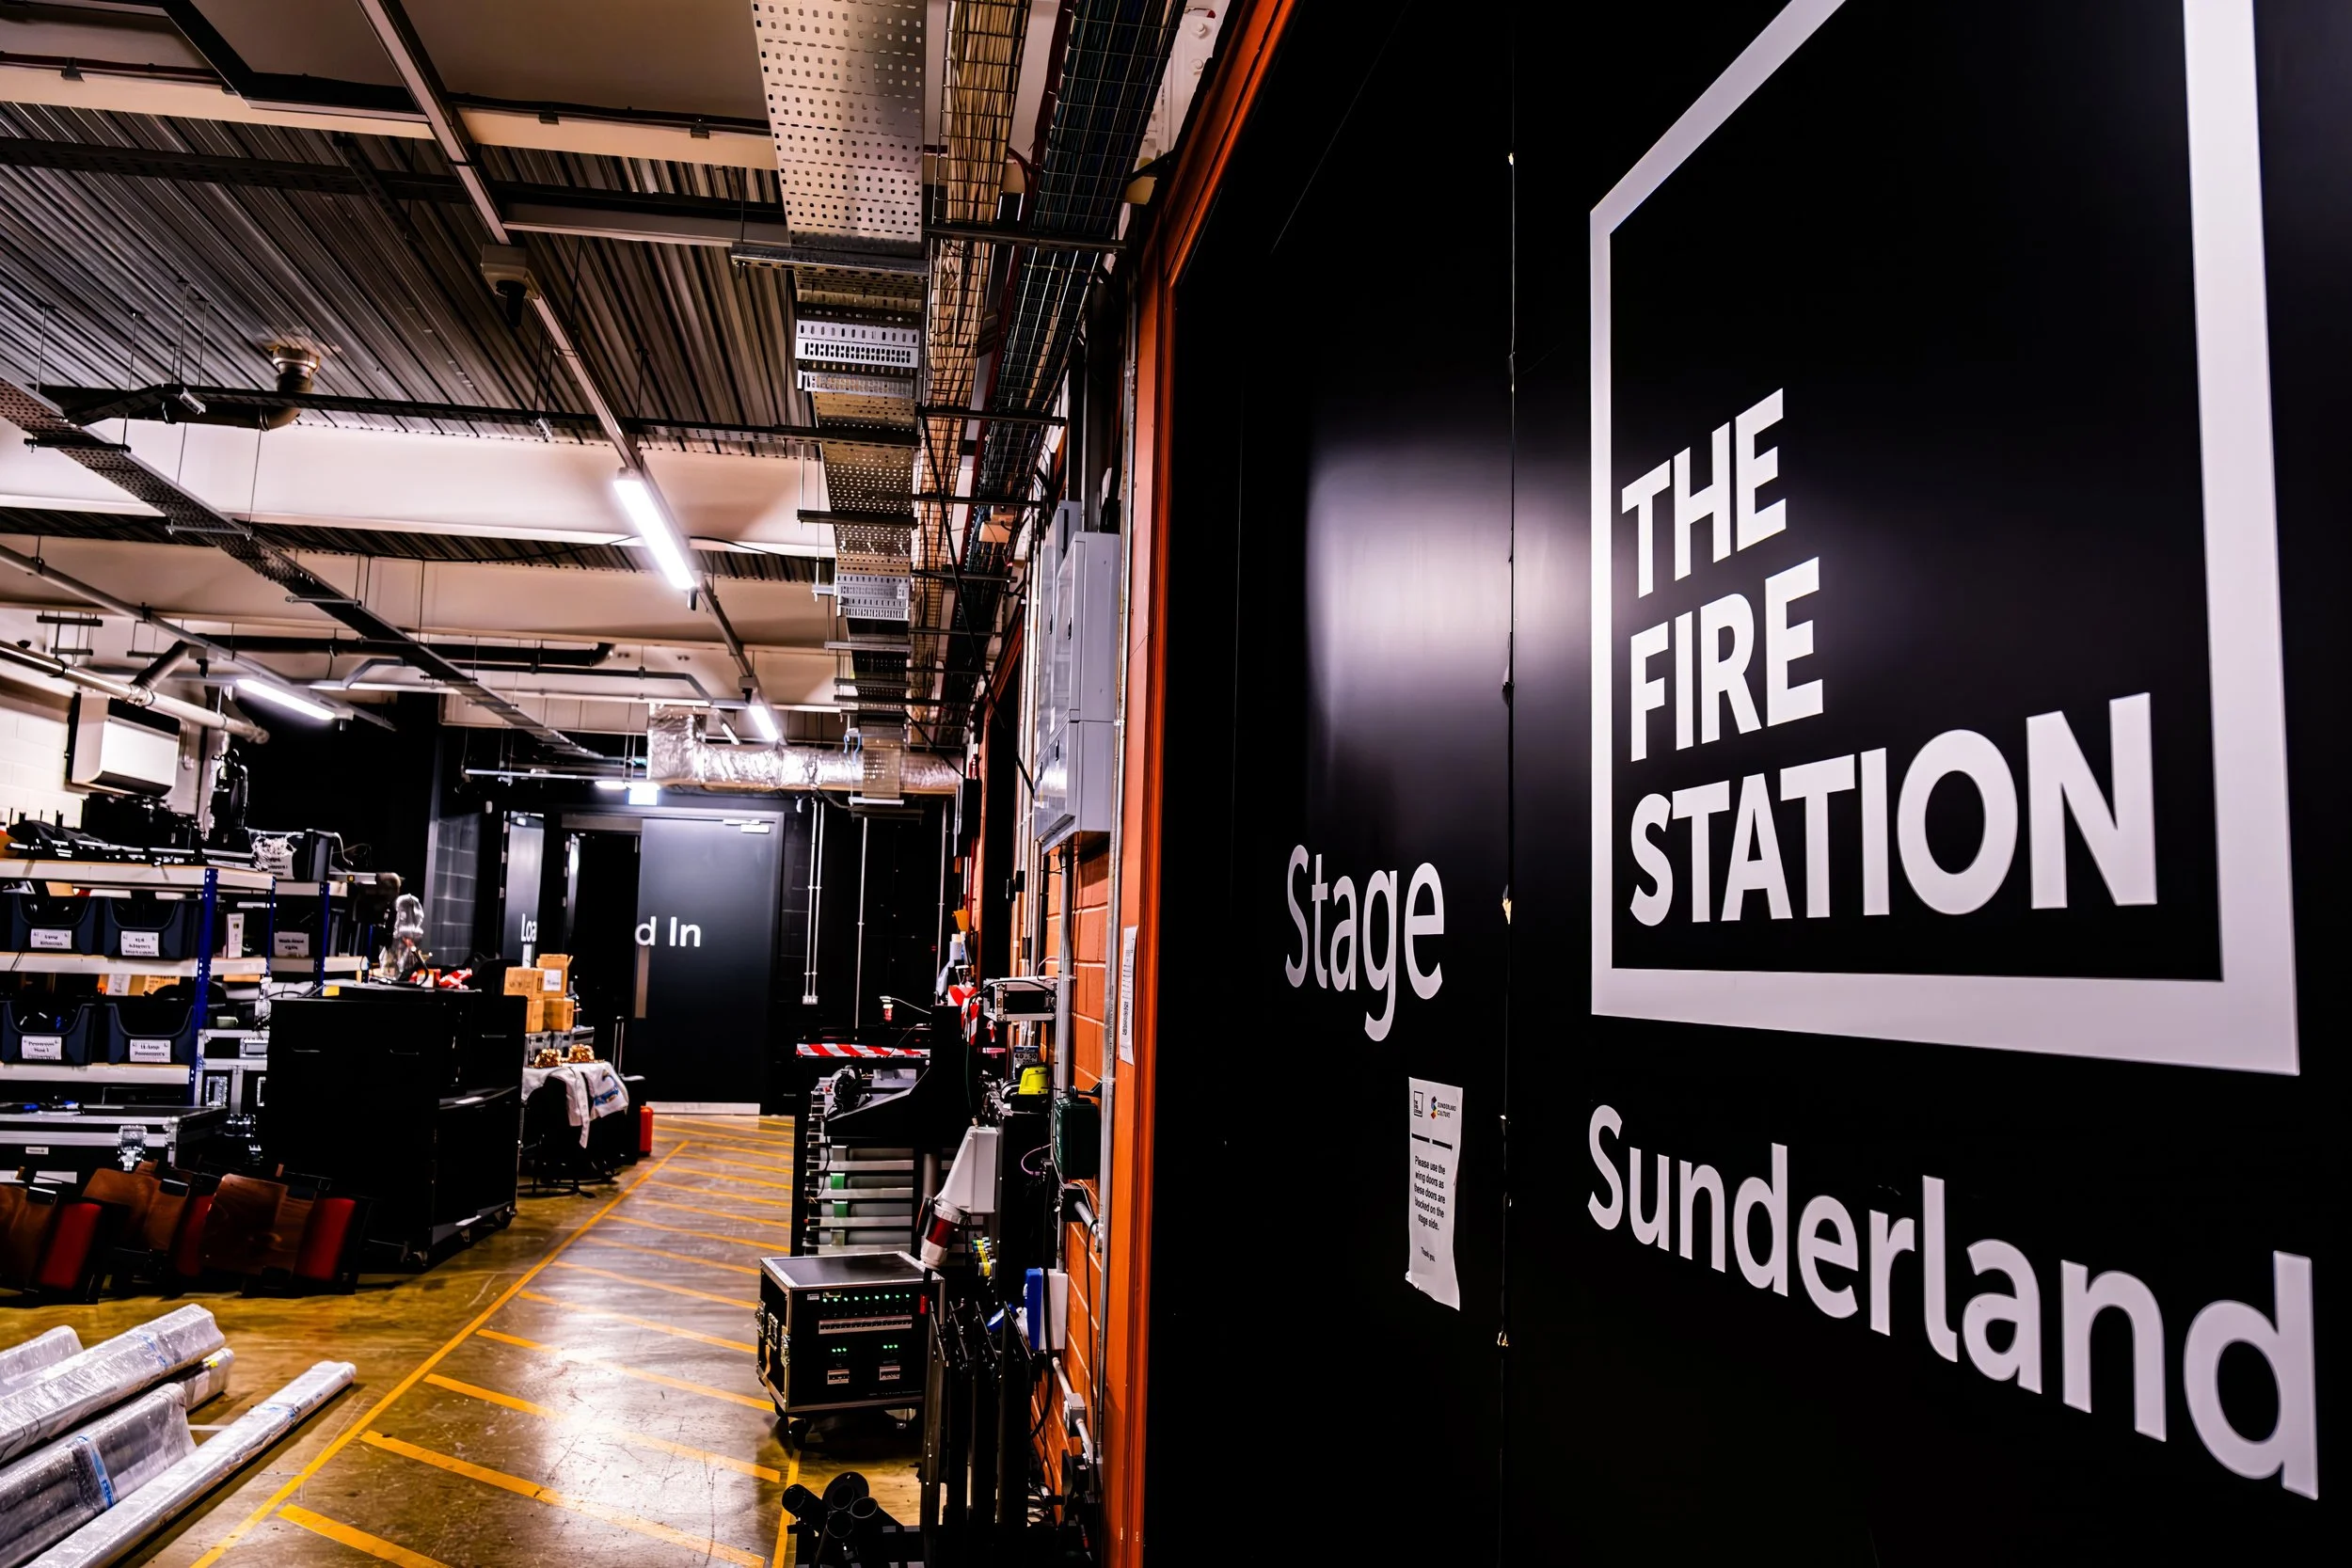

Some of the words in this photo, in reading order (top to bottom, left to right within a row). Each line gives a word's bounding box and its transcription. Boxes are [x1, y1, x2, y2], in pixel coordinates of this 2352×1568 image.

[1621, 388, 1787, 599] THE
[1629, 557, 1824, 763] FIRE
[1629, 691, 2158, 927] STATION
[669, 916, 702, 947] In
[1285, 844, 1445, 1042] Stage
[1414, 1155, 1429, 1169] Please
[1414, 1182, 1424, 1196] these
[1424, 1187, 1438, 1200] doors
[1438, 1194, 1446, 1204] are
[1425, 1174, 1438, 1187] doors
[1438, 1180, 1445, 1189] as
[1414, 1196, 1429, 1212] blocked
[1430, 1206, 1436, 1214] on
[1418, 1213, 1428, 1227] stage
[1587, 1104, 2319, 1500] Sunderland
